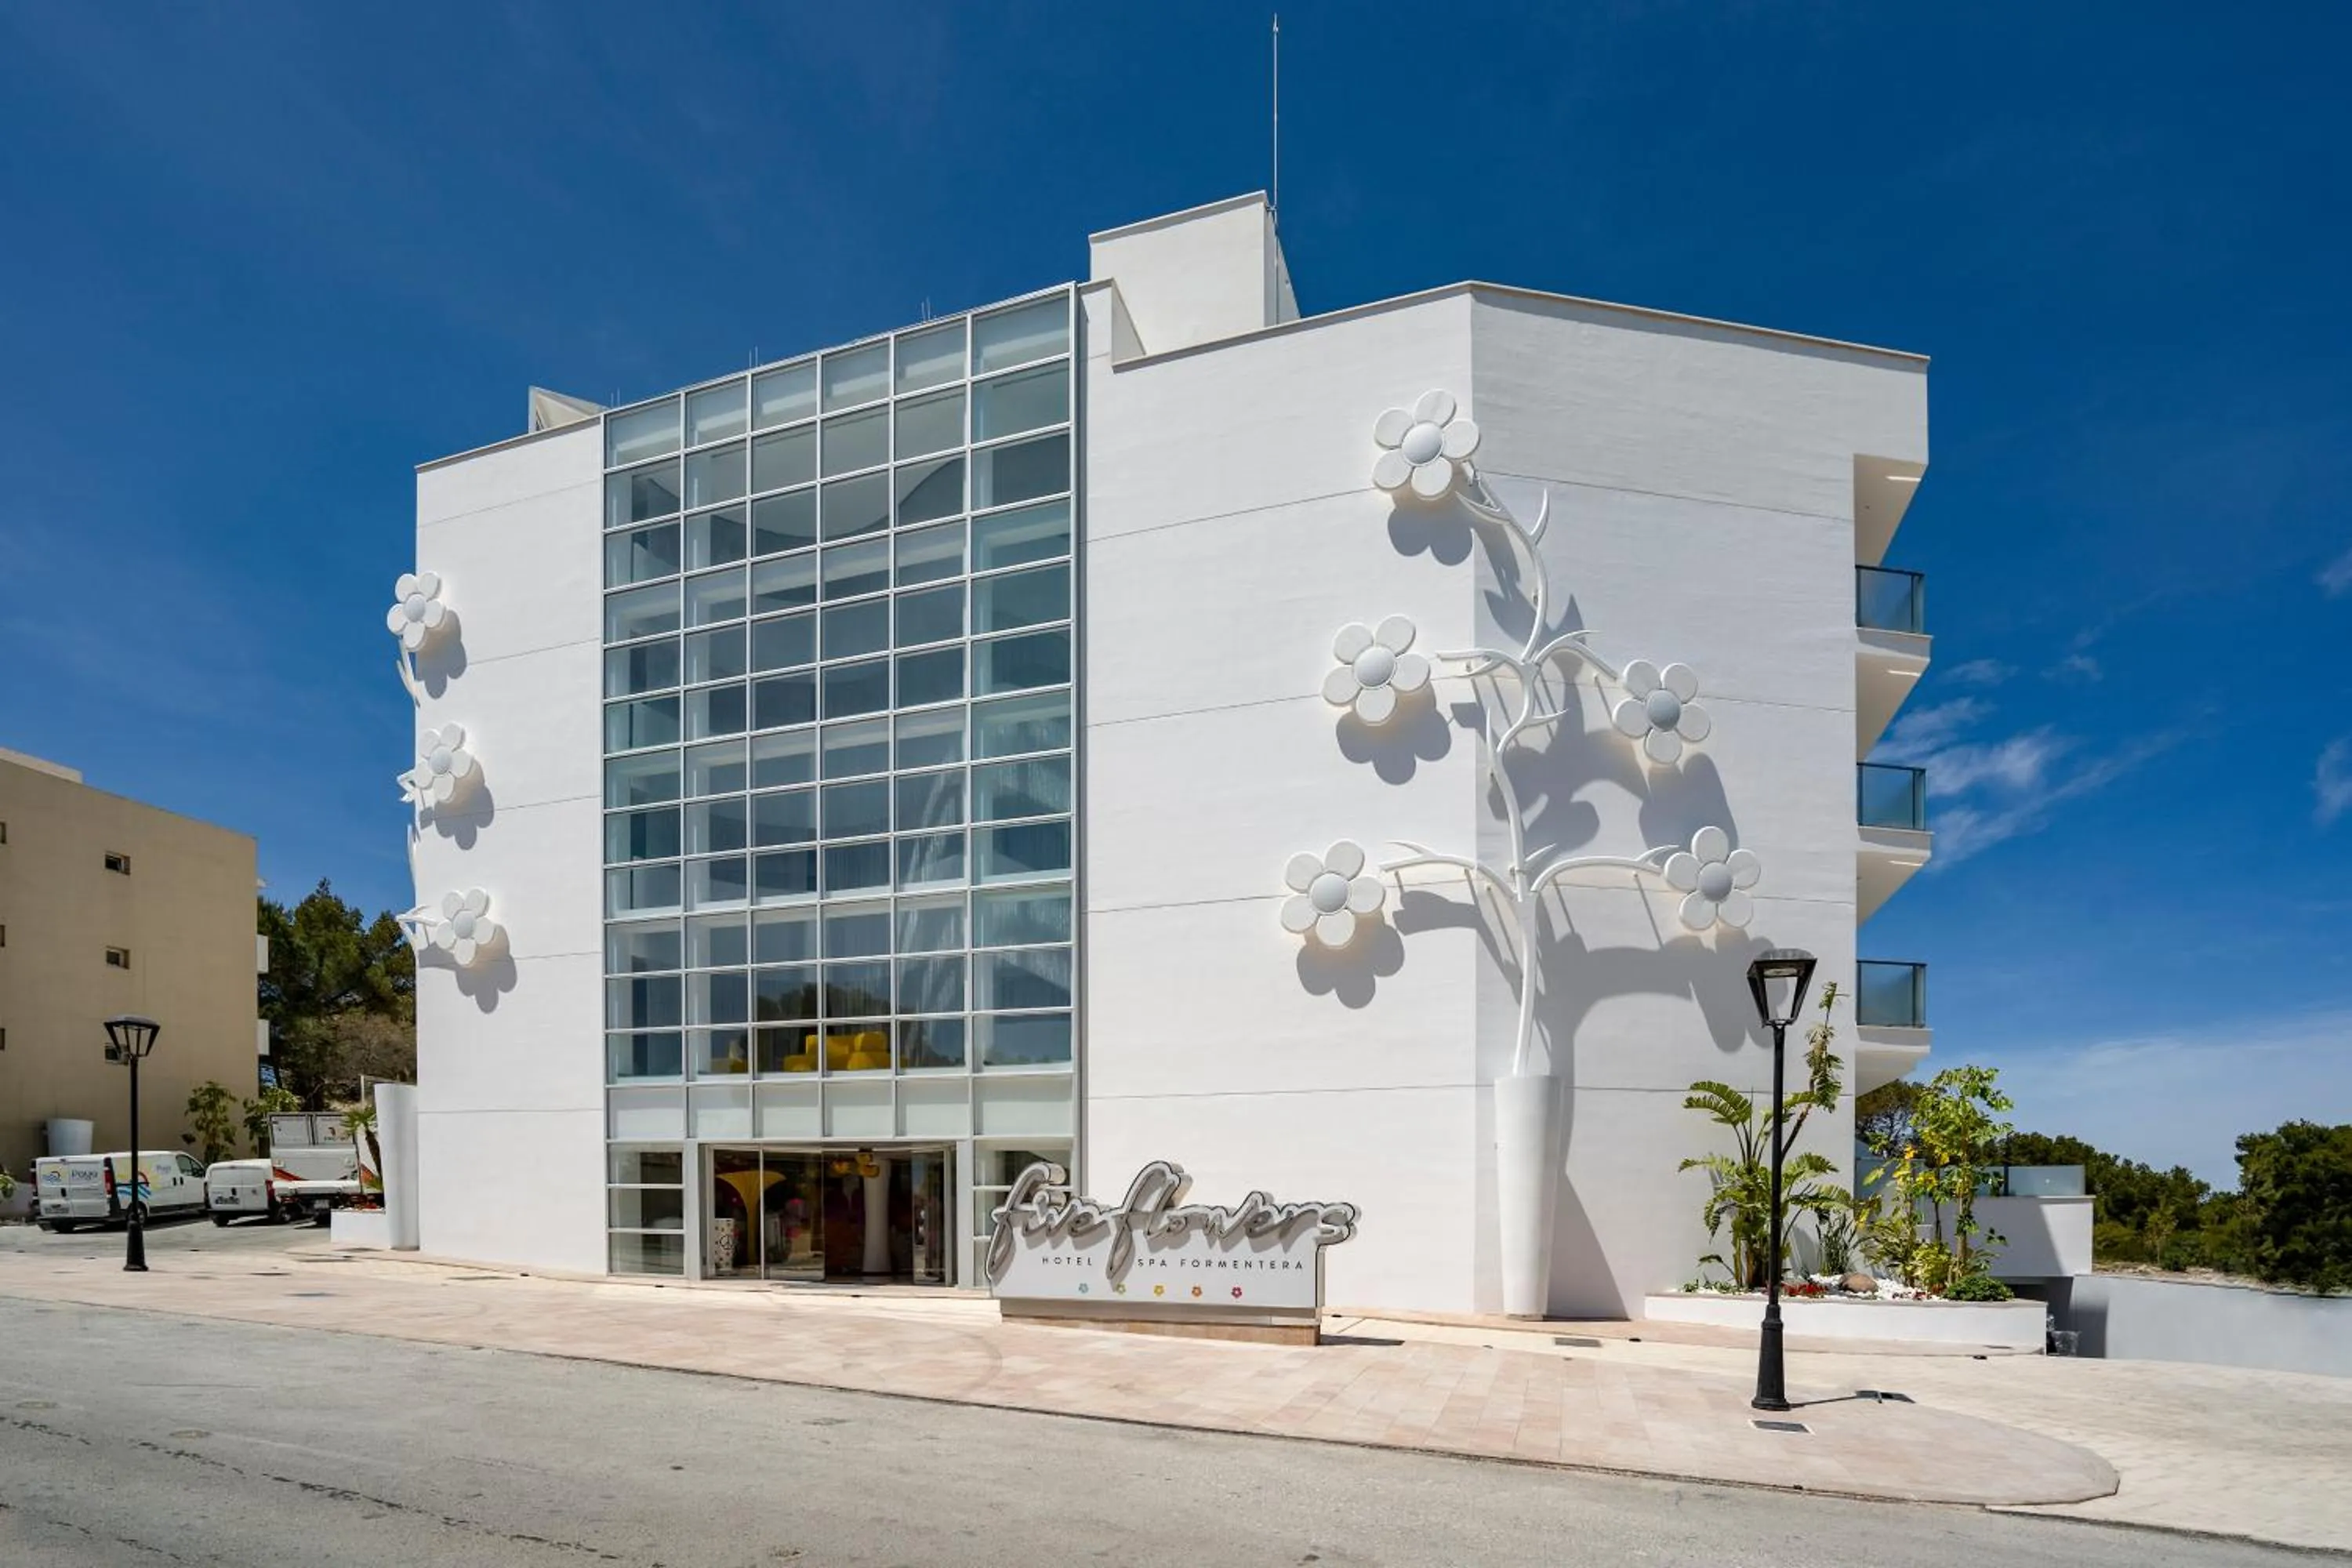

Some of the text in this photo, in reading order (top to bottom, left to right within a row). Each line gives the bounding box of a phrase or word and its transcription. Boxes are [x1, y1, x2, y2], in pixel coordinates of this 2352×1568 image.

[1042, 1257, 1304, 1270] HOTEL SPA FORMENTERA
